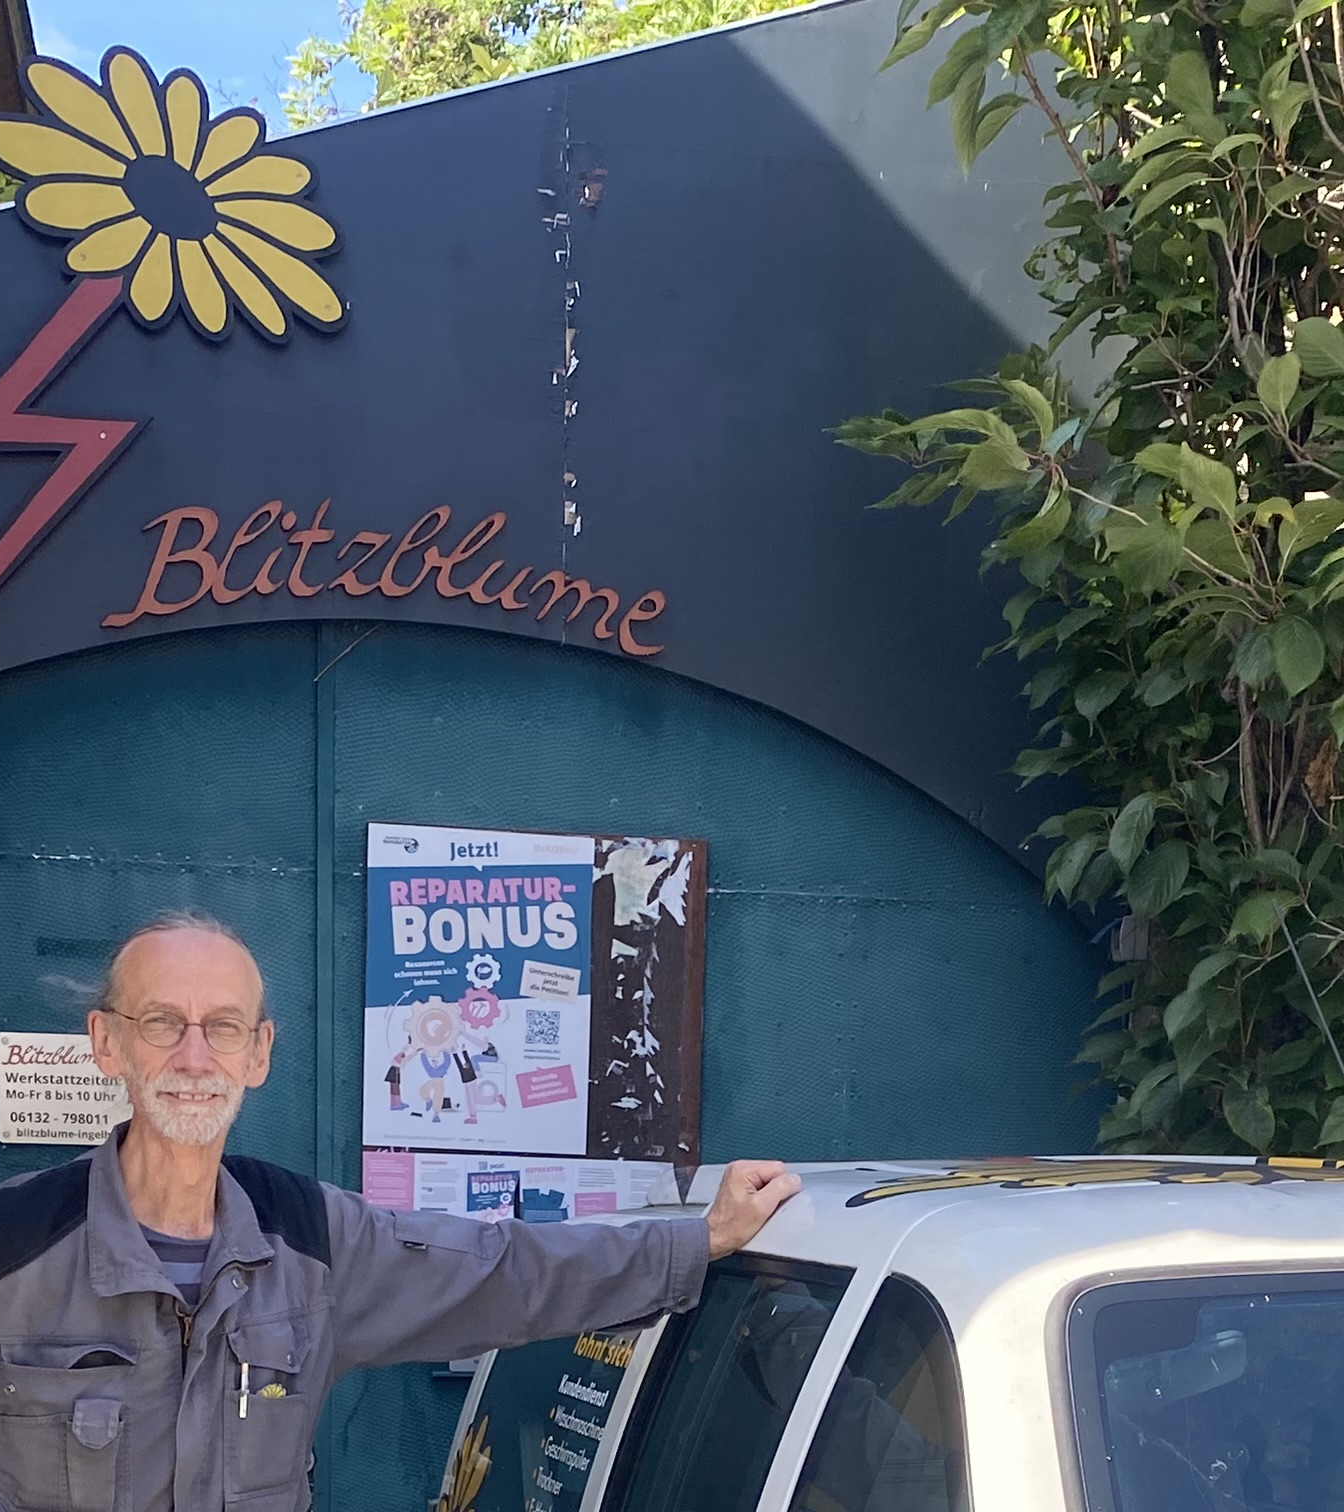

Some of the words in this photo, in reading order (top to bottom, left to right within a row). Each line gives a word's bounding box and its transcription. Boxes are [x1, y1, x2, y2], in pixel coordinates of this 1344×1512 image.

[101, 497, 665, 656] Blitzblume
[450, 841, 499, 861] Jetzt!
[389, 876, 577, 907] REPARATUR-
[391, 901, 578, 955] BONUS
[529, 967, 575, 981] Unterschreibe
[543, 978, 558, 987] jetzt
[541, 986, 570, 996] Petition!
[1, 1045, 97, 1065] Blitzblum
[5, 1072, 123, 1086] Werkstattzeiten:
[6, 1089, 42, 1100] Mo-Fr
[44, 1090, 52, 1100] 8
[55, 1090, 73, 1101] bis
[76, 1091, 91, 1102] 10
[93, 1091, 117, 1102] Uhr
[10, 1111, 50, 1123] 06132
[62, 1113, 109, 1125] 798011
[472, 1179, 516, 1195] BONUS
[573, 1331, 610, 1360] lohnt
[604, 1338, 634, 1368] sich
[558, 1373, 610, 1407] Kundendienst
[536, 1465, 564, 1496] Trockner
